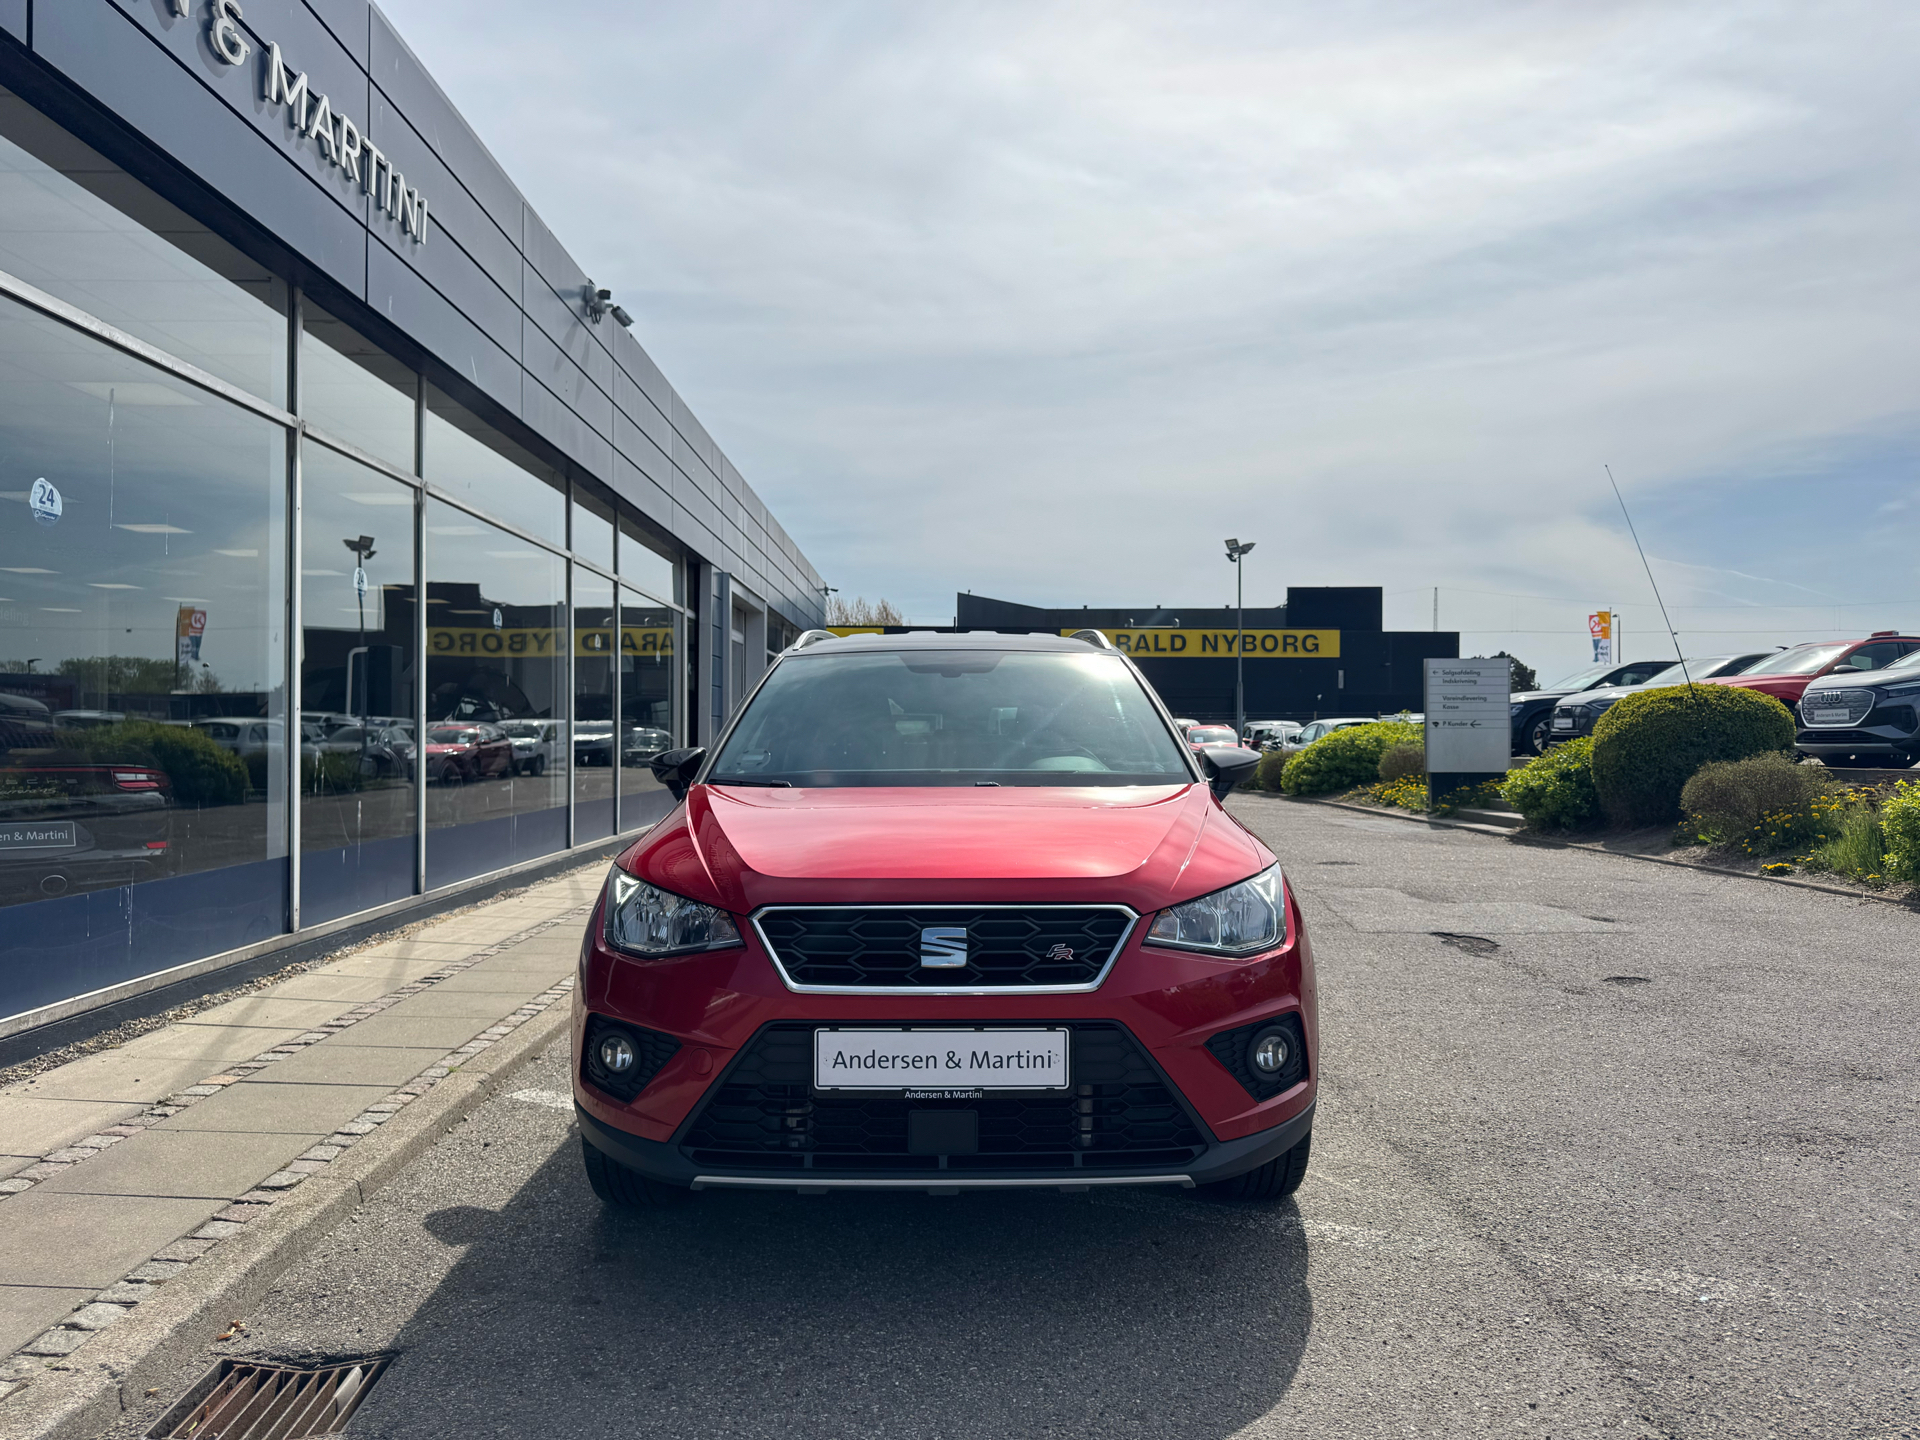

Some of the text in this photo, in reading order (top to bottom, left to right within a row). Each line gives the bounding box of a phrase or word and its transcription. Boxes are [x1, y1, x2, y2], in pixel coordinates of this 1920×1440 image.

[266, 40, 428, 245] MARTINI
[39, 484, 55, 507] 24
[1115, 634, 1320, 652] RALD NYBORG
[1442, 669, 1481, 677] Salgsafdeling
[14, 831, 23, 841] &
[26, 829, 68, 840] Martini
[831, 1049, 1052, 1069] Andersen & Martini
[904, 1090, 983, 1099] Andersen & Martini
